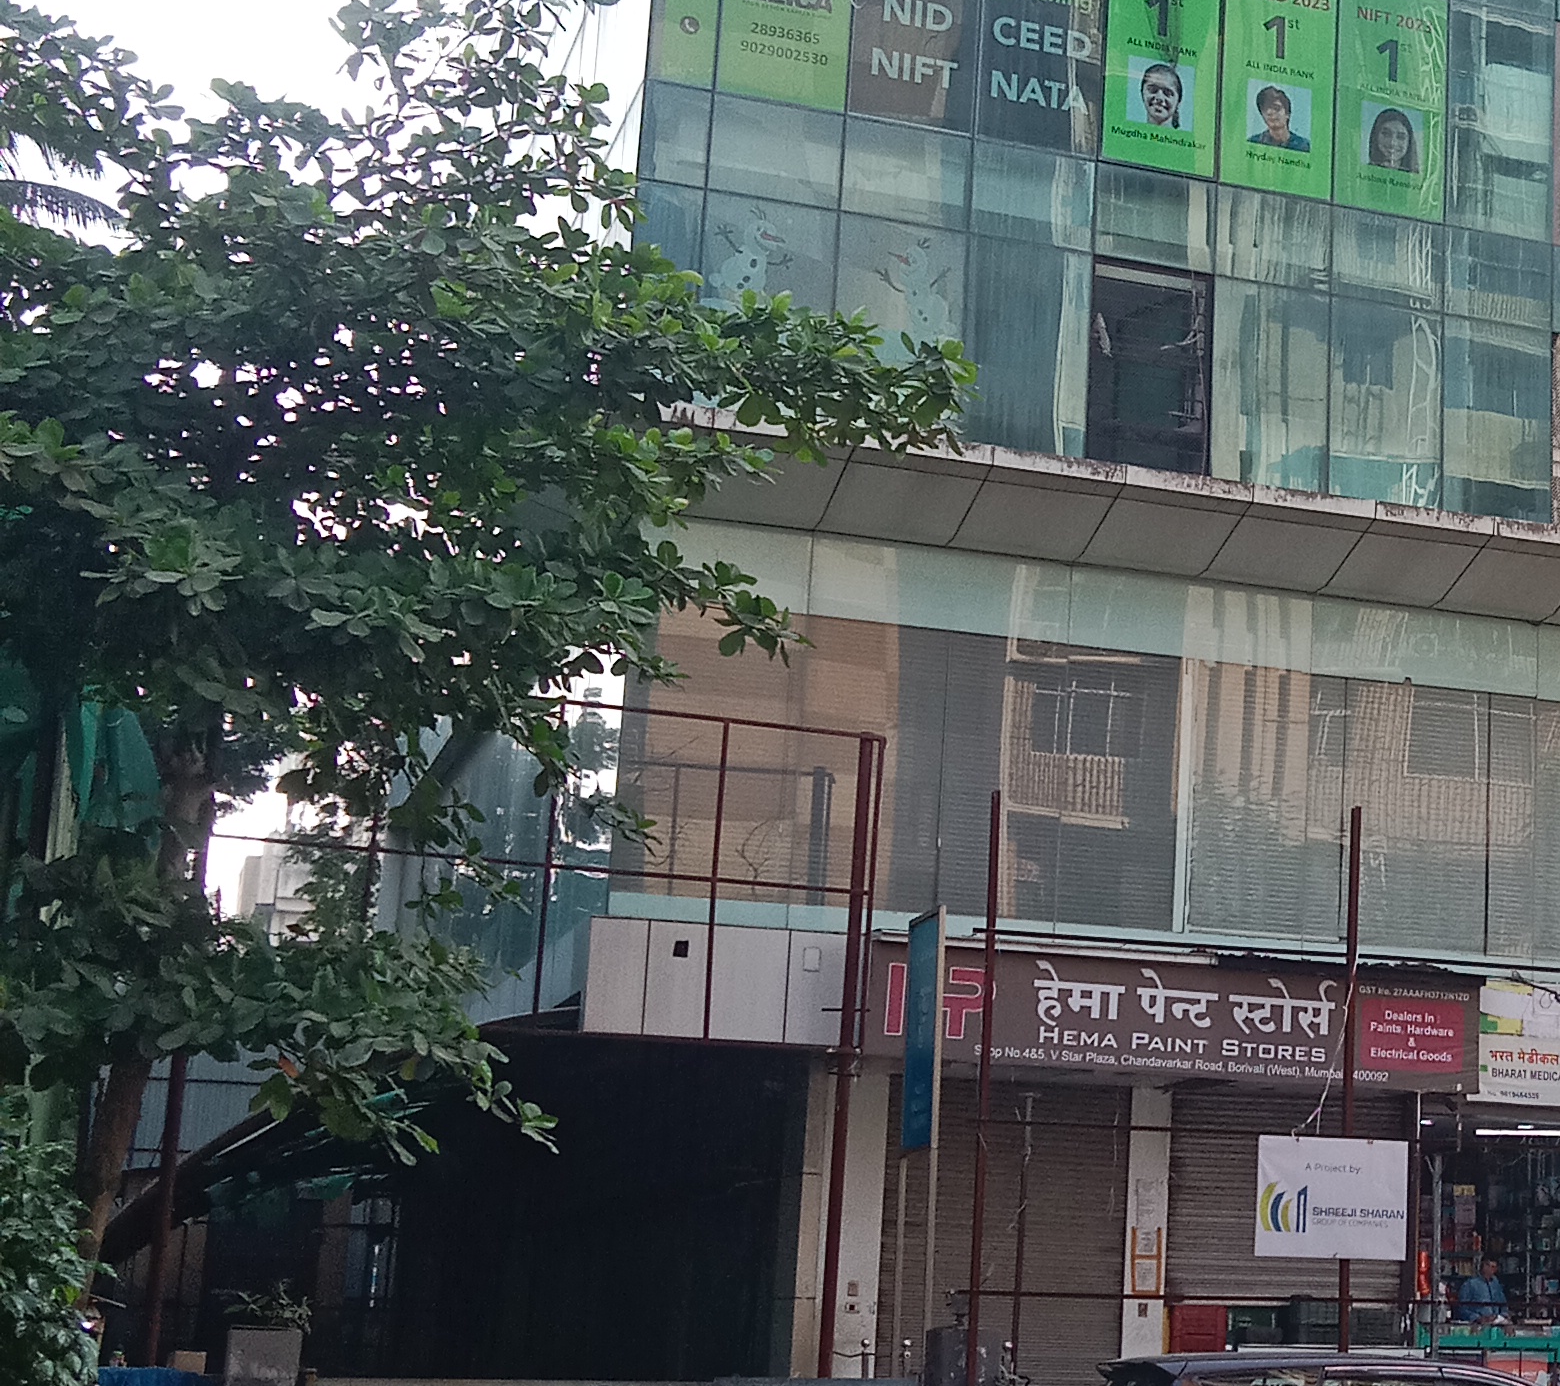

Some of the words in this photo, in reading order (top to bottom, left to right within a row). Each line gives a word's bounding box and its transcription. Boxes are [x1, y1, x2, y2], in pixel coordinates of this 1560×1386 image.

[1357, 6, 1391, 26] NIFT
[751, 22, 820, 44] 28936365
[993, 17, 1092, 59] CEED
[1127, 37, 1143, 47] ALL
[741, 40, 828, 66] 9029002530
[871, 47, 959, 89] NIFT
[1246, 60, 1261, 69] ALL
[1263, 64, 1288, 75] INDIA
[1290, 68, 1314, 80] RANK
[990, 70, 1089, 114] NATA
[1111, 126, 1148, 141] Mugdha
[1033, 959, 1126, 1026] हेमा
[1137, 968, 1219, 1028] पेन्ट
[1228, 978, 1337, 1039] स्टोर्स
[1385, 1010, 1422, 1022] Dealers
[1407, 1025, 1454, 1037] Hardware
[1408, 1037, 1416, 1047] &
[974, 1044, 1002, 1059] Sop
[1061, 1050, 1083, 1062] Star
[1121, 1054, 1193, 1069] Chandavarkar
[1228, 1062, 1265, 1075] Borivali
[1352, 1070, 1389, 1082] 400092
[1370, 1047, 1418, 1060] Electrical
[1419, 1050, 1453, 1062] Goods
[1491, 1068, 1527, 1080] BHARAT
[1314, 1164, 1346, 1173] Project
[1312, 1206, 1357, 1217] SHREEJI
[1360, 1208, 1405, 1220] SHARAN
